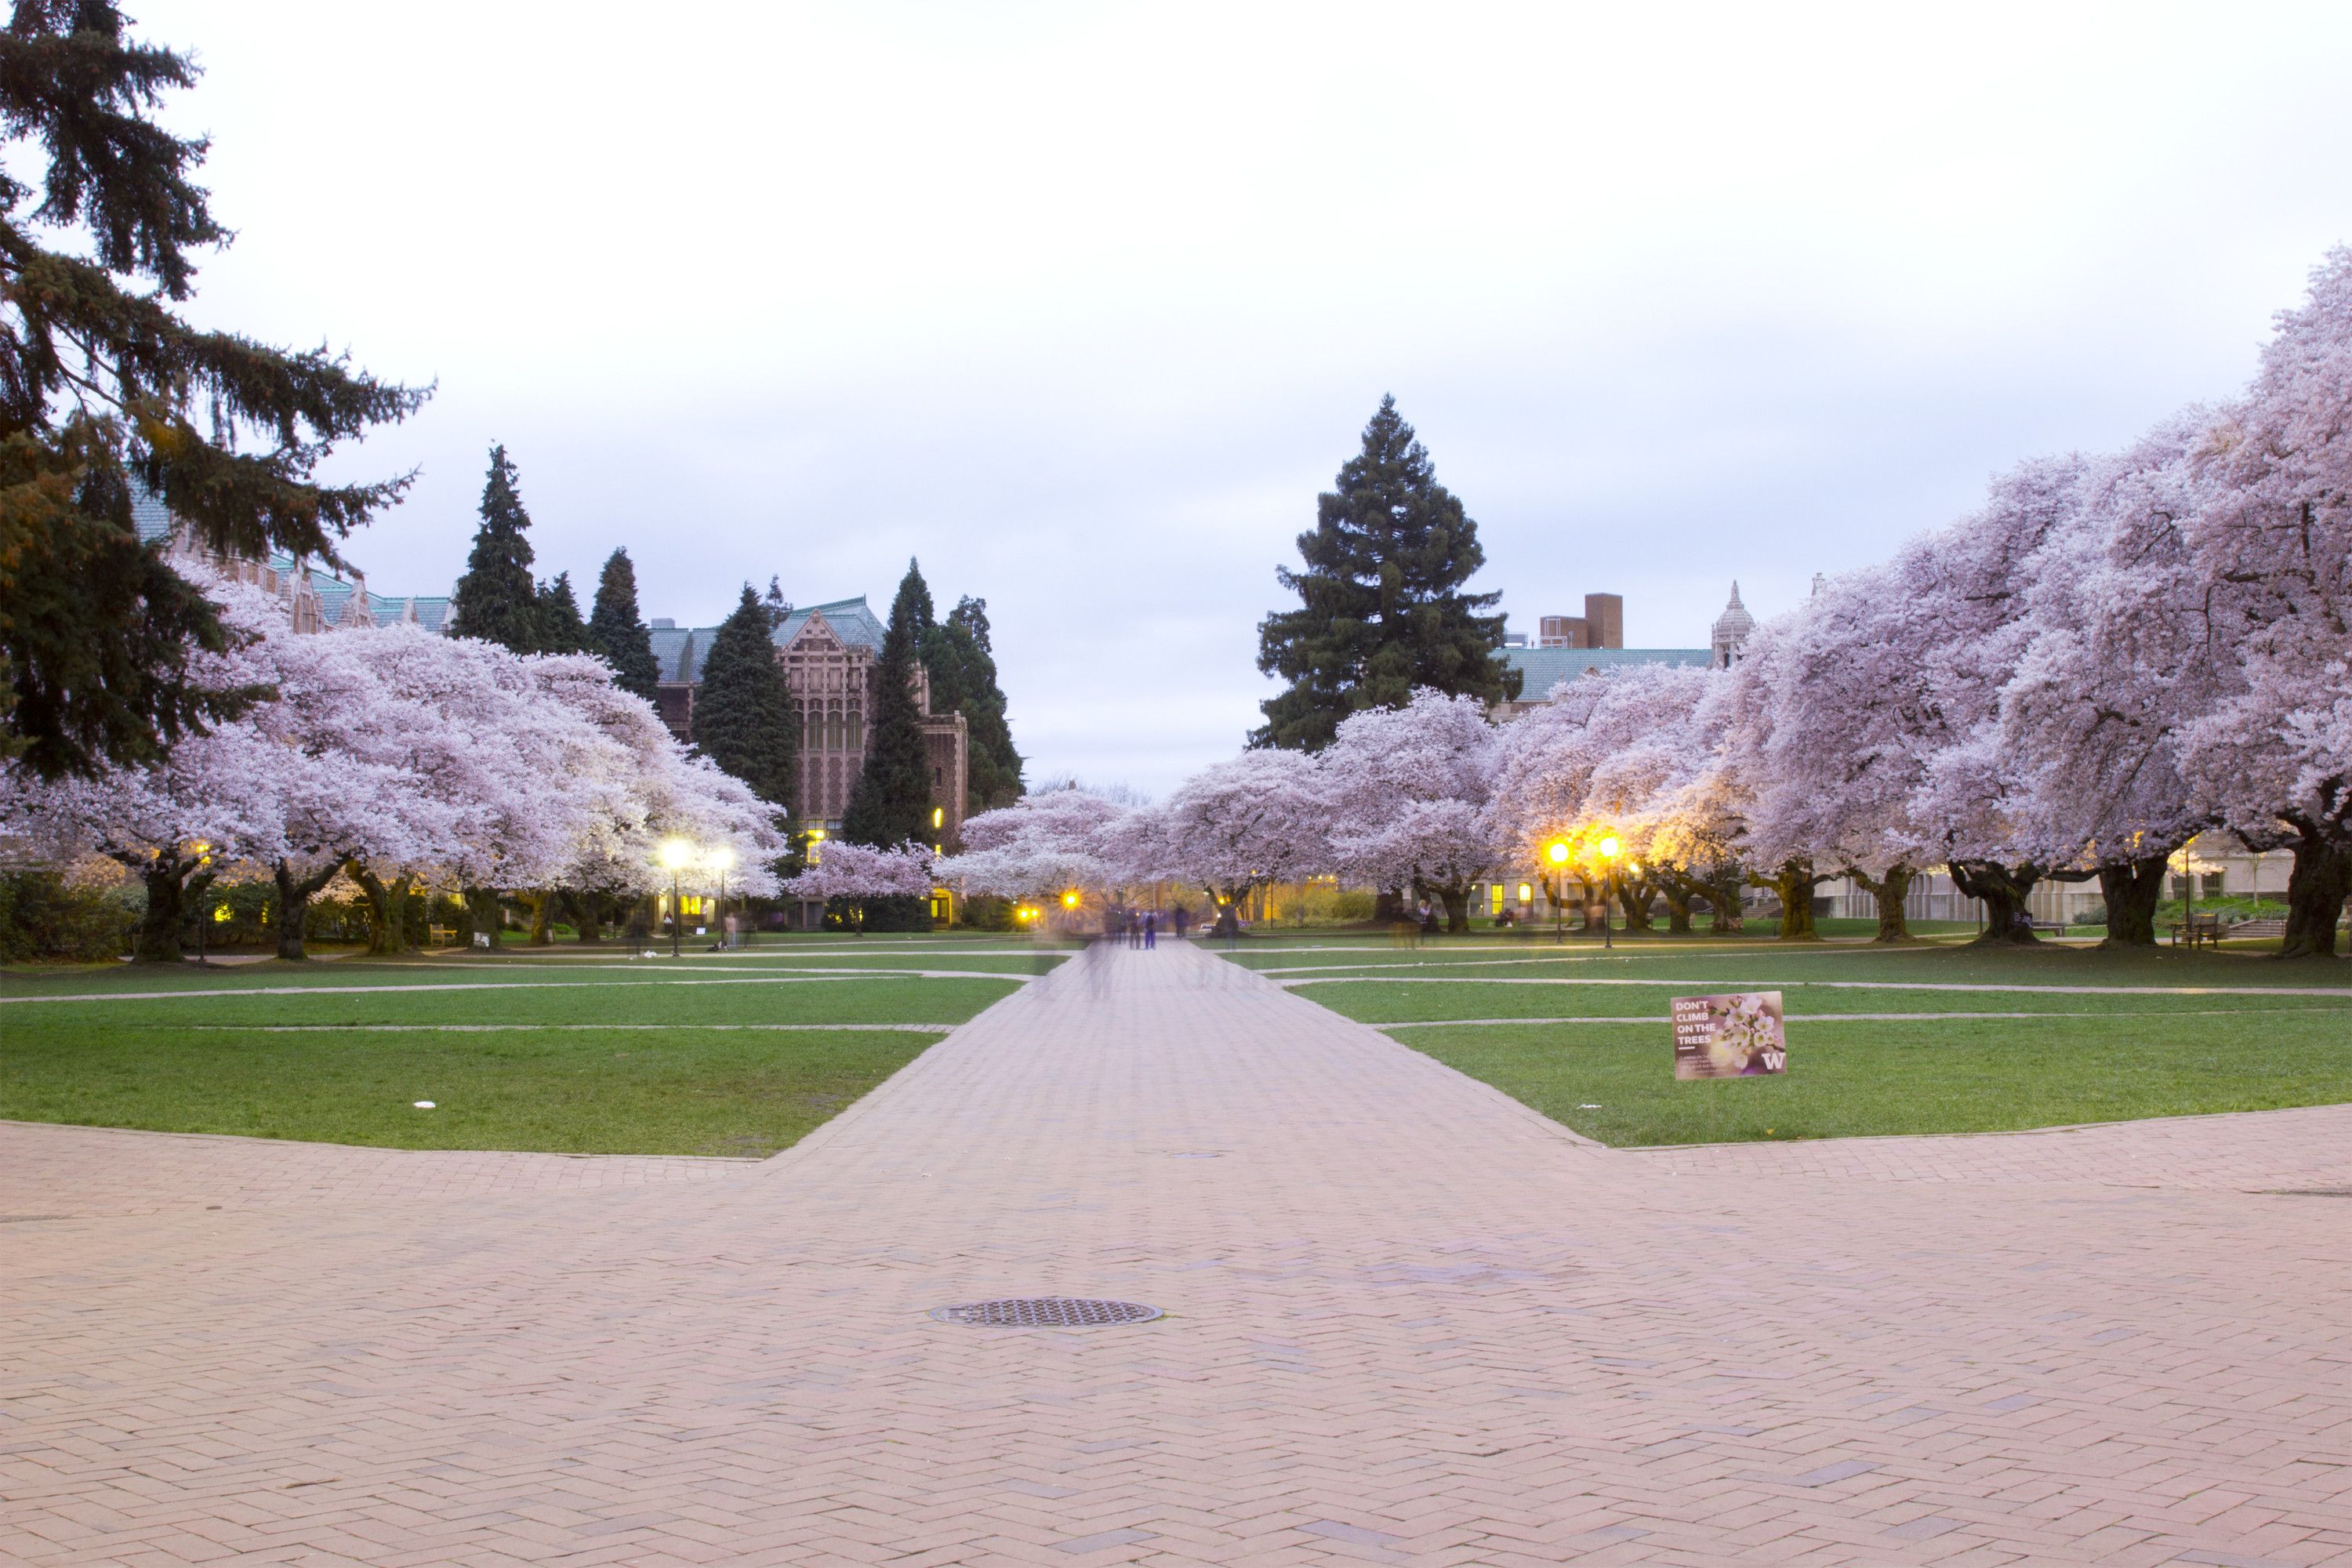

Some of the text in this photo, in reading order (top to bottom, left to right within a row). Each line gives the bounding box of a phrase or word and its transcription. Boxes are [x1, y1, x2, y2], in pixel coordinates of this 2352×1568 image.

[1676, 1001, 1708, 1011] DON'T
[1677, 1013, 1708, 1022] CLIMB
[1694, 1023, 1716, 1033] THE
[1678, 1036, 1711, 1044] TREES
[1762, 1053, 1786, 1069] W
